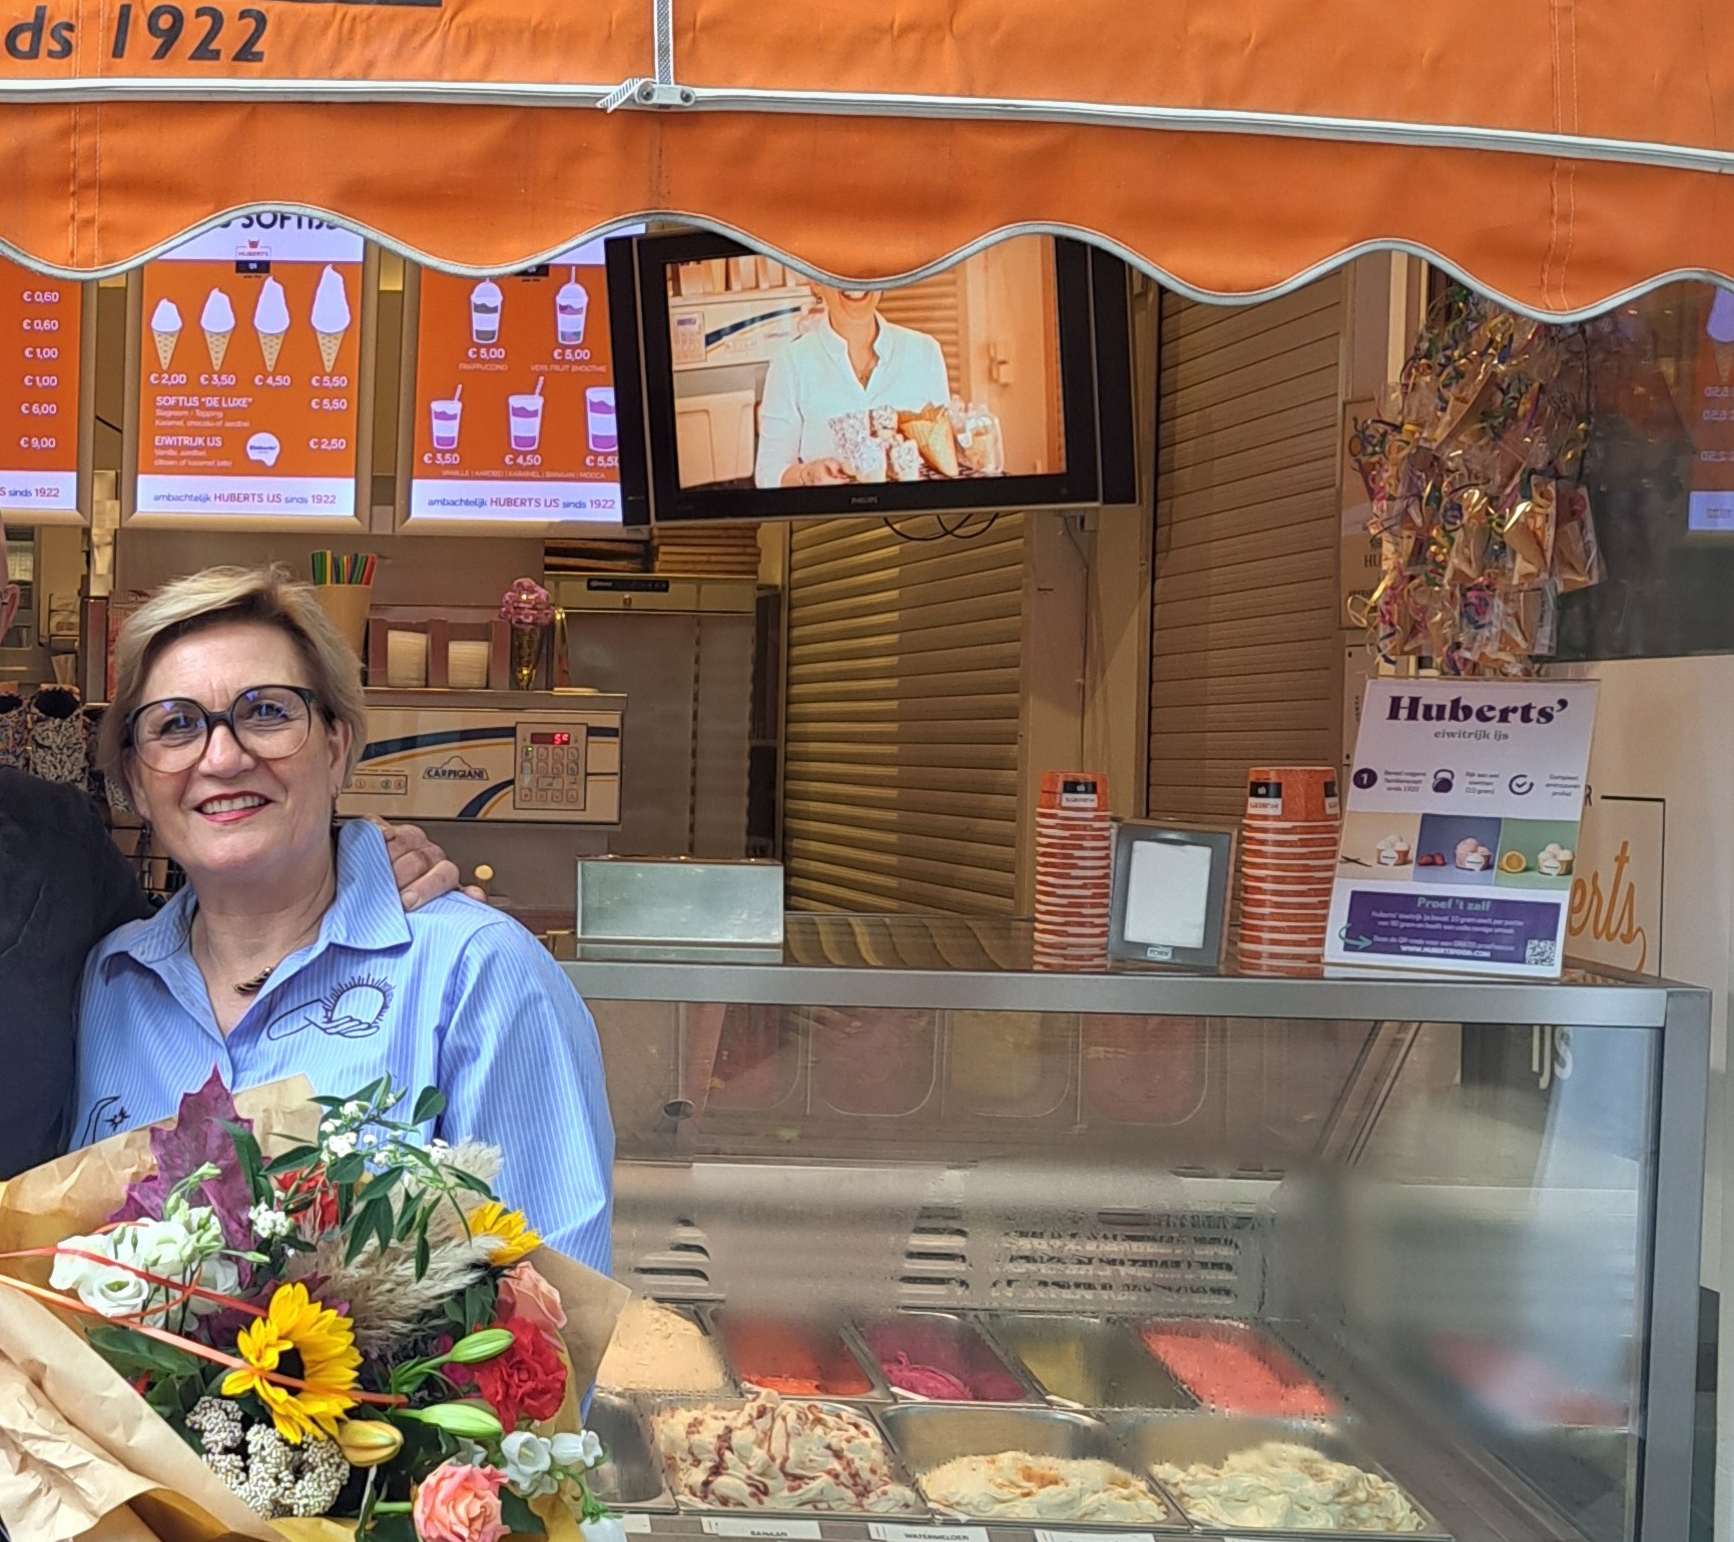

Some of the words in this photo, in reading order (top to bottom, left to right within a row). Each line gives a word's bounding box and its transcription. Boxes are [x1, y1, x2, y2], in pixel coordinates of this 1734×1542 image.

[112, 2, 267, 64] 1922
[34, 291, 60, 304] 0,60
[33, 319, 59, 332] 0,60
[36, 348, 59, 360] 1,00
[480, 348, 506, 360] 5,00
[35, 375, 58, 388] 1,00
[161, 374, 187, 386] 2,00
[156, 396, 199, 407] SOFTIJS
[32, 404, 57, 416] 6,00
[31, 437, 56, 450] 9,00
[206, 436, 222, 448] IJS
[8, 487, 33, 498] sinds
[34, 488, 60, 498] 1922
[213, 493, 264, 503] HUBERTS
[266, 493, 282, 504] IJS
[311, 494, 336, 504] 1922
[427, 497, 488, 507] ambachtelijk
[490, 497, 542, 507] HUBERTS
[544, 497, 559, 508] IJS
[561, 500, 587, 509] sinds
[589, 499, 616, 509] 1922
[1386, 695, 1569, 725] Huberts'
[1433, 728, 1491, 742] eiwitrijk
[1493, 729, 1509, 742] ijs
[426, 768, 485, 780] CARPIGIANI
[1417, 897, 1453, 909] Proef
[1455, 899, 1464, 910] 't
[1466, 900, 1492, 912] zelf
[1531, 1024, 1574, 1090] IJS
[904, 1532, 969, 1541] WATERMELOEN
